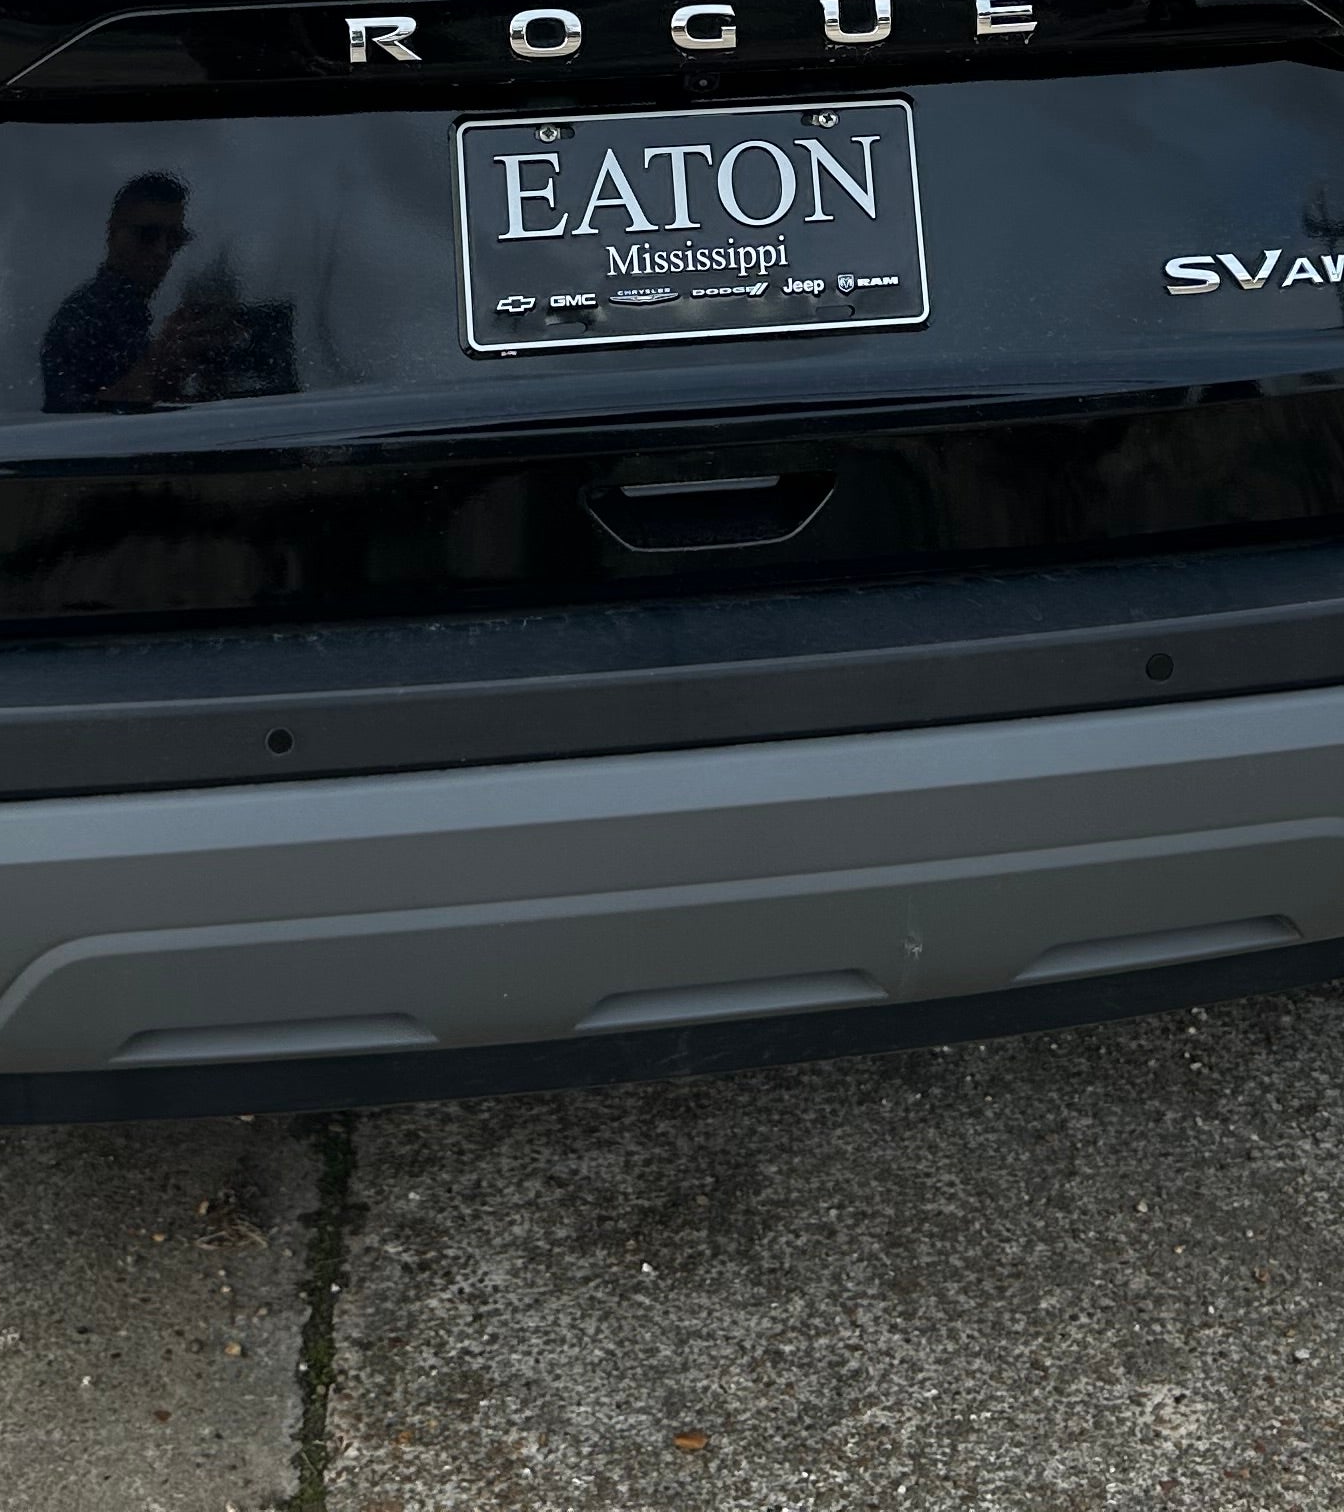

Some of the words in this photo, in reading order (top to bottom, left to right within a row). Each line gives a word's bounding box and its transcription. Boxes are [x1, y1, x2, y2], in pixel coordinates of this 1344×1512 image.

[493, 135, 881, 241] EATON
[605, 234, 790, 277] Mississippi
[1165, 248, 1283, 295] SV
[550, 292, 597, 308] GMC
[782, 276, 825, 295] Jeep
[857, 275, 899, 287] RAM
